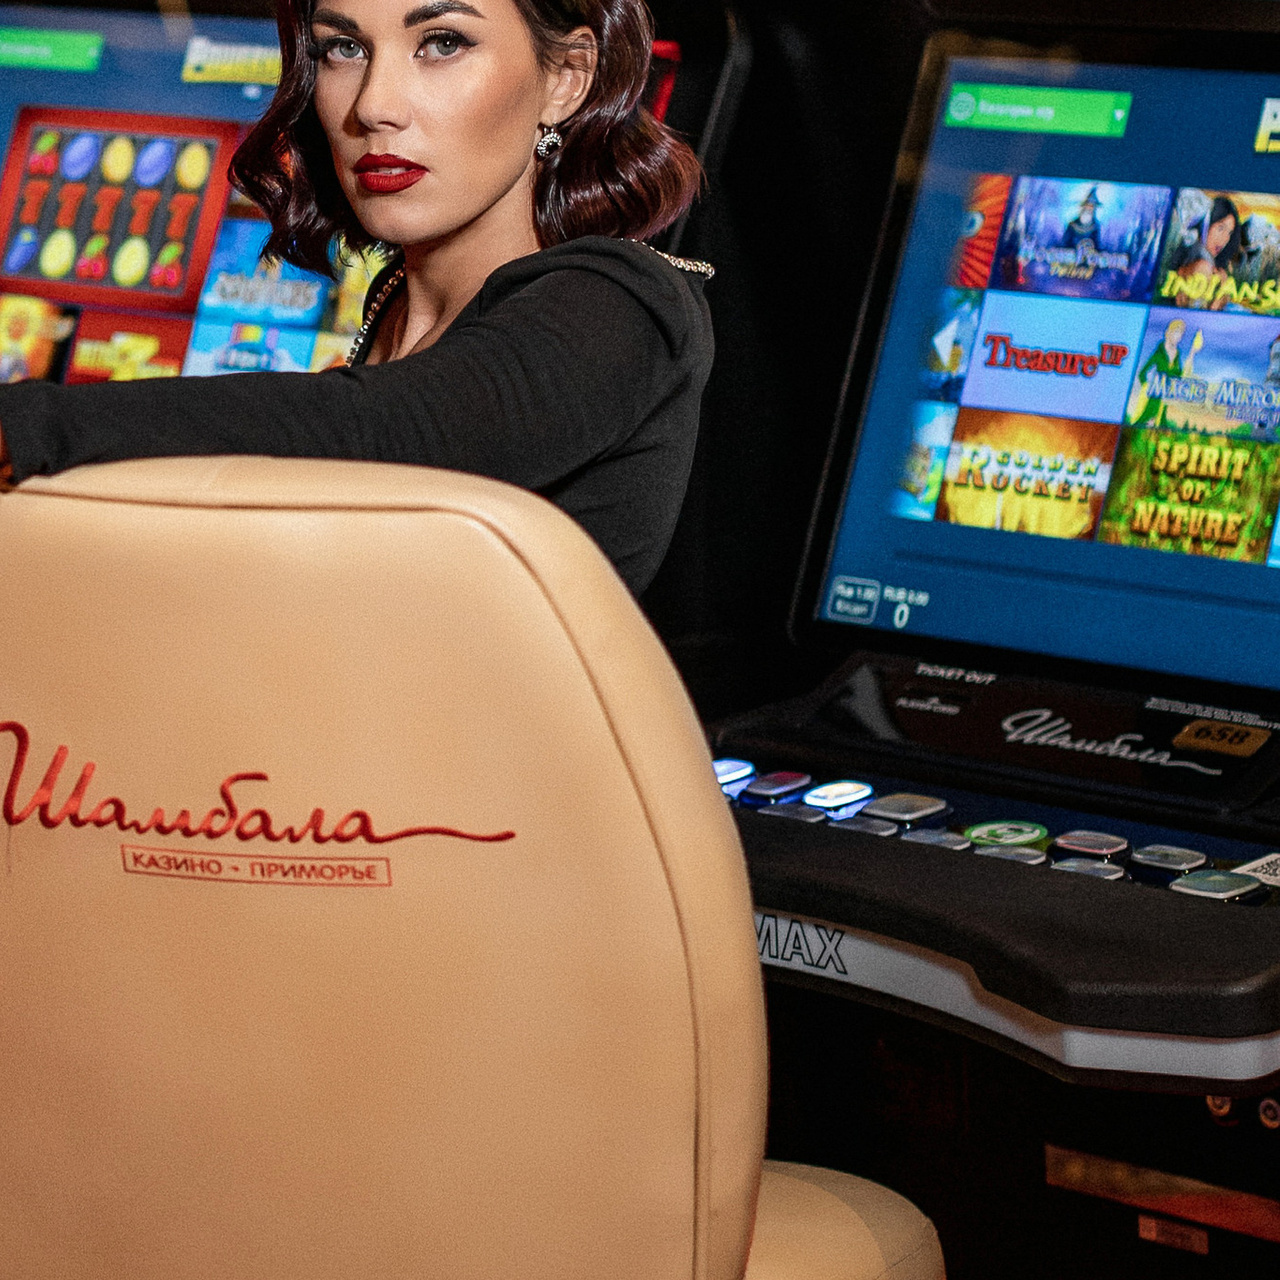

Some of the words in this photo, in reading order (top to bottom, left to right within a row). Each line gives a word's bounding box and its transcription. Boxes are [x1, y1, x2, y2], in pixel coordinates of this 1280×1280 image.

[983, 334, 1099, 377] Treasure
[1100, 342, 1129, 367] UP
[1213, 378, 1280, 408] MIRRO
[954, 444, 1095, 503] ROCKET
[996, 449, 1100, 477] GOLDEN
[1153, 440, 1251, 481] SPIRIT
[1130, 498, 1244, 546] NATURE
[894, 603, 909, 628] 0
[132, 852, 222, 876] КАЗИНО
[250, 860, 378, 882] ПРИМОРЬЕ
